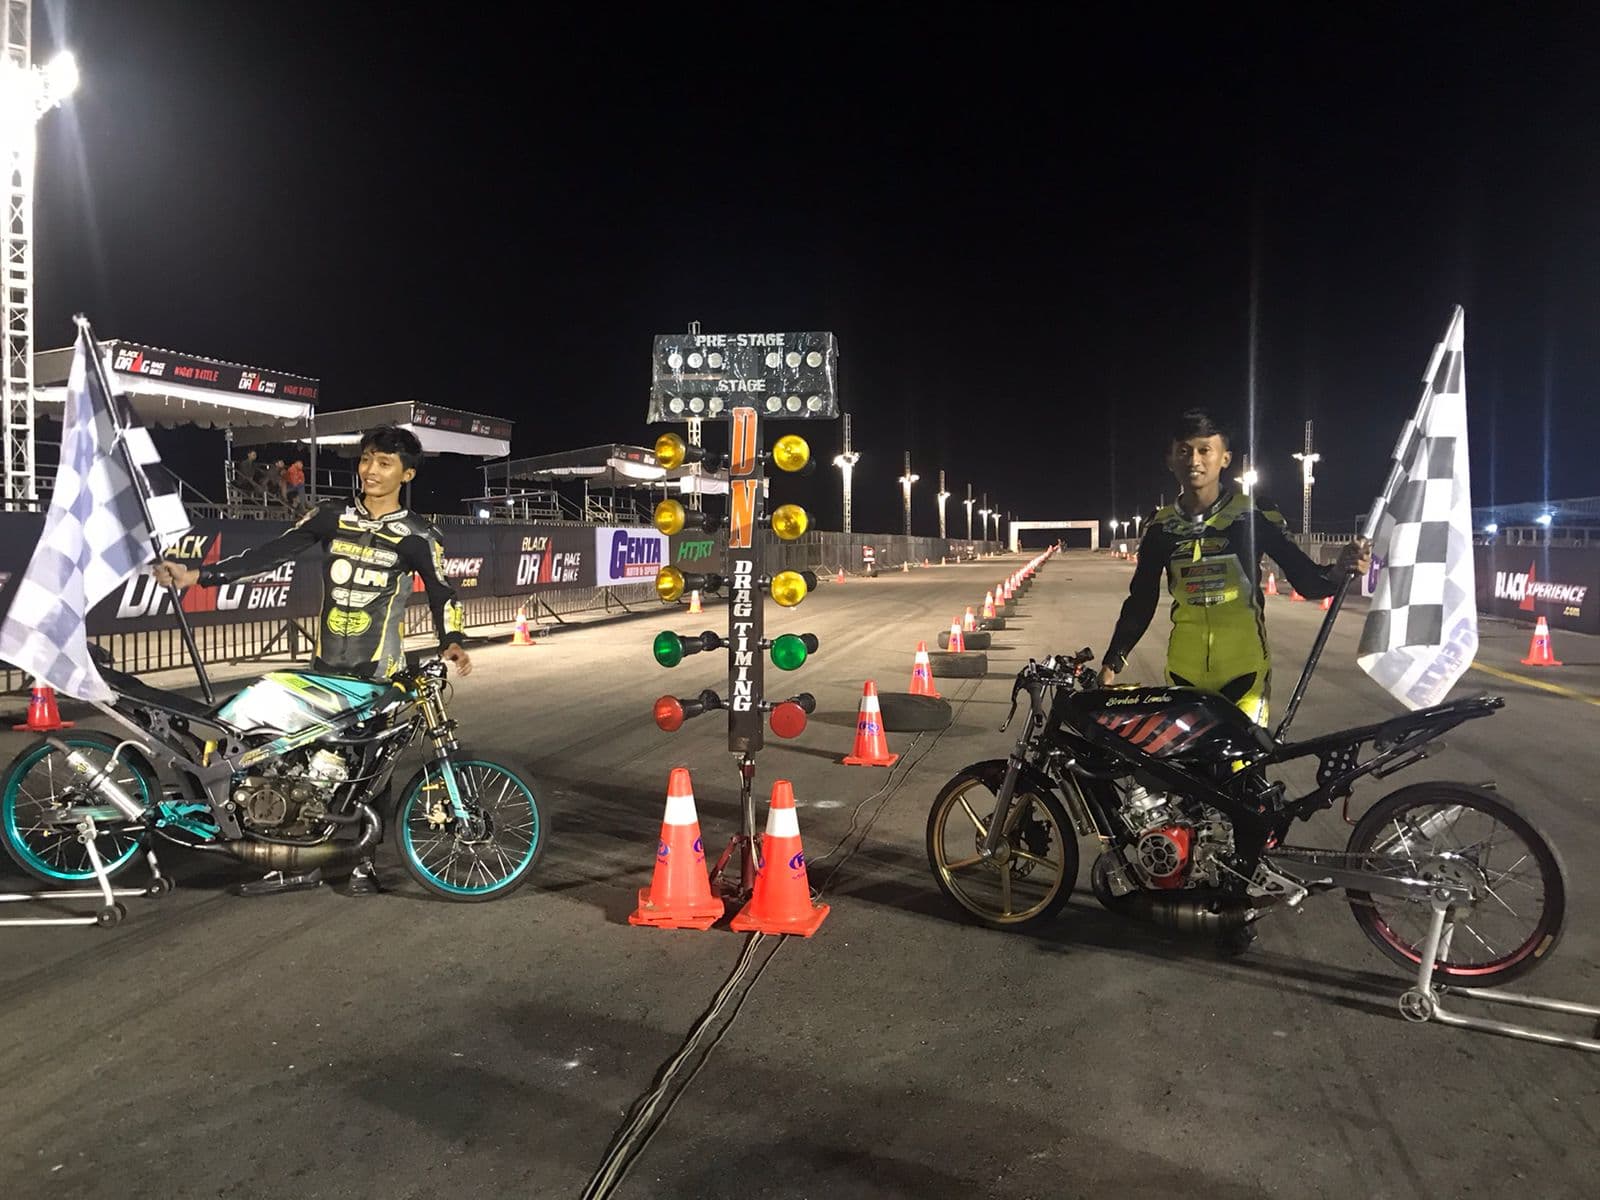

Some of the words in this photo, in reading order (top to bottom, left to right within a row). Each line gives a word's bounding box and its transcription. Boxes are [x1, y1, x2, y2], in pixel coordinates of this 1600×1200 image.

[695, 333, 785, 347] PRE-STAGE
[718, 380, 766, 392] STAGE
[521, 536, 548, 552] BLACK
[609, 529, 661, 579] GENTA
[516, 548, 562, 586] DRAG
[564, 552, 581, 566] RACE
[563, 568, 579, 582] BIKE
[247, 585, 290, 610] BIKE
[733, 560, 753, 617] DRAG
[733, 622, 753, 712] TIMING
